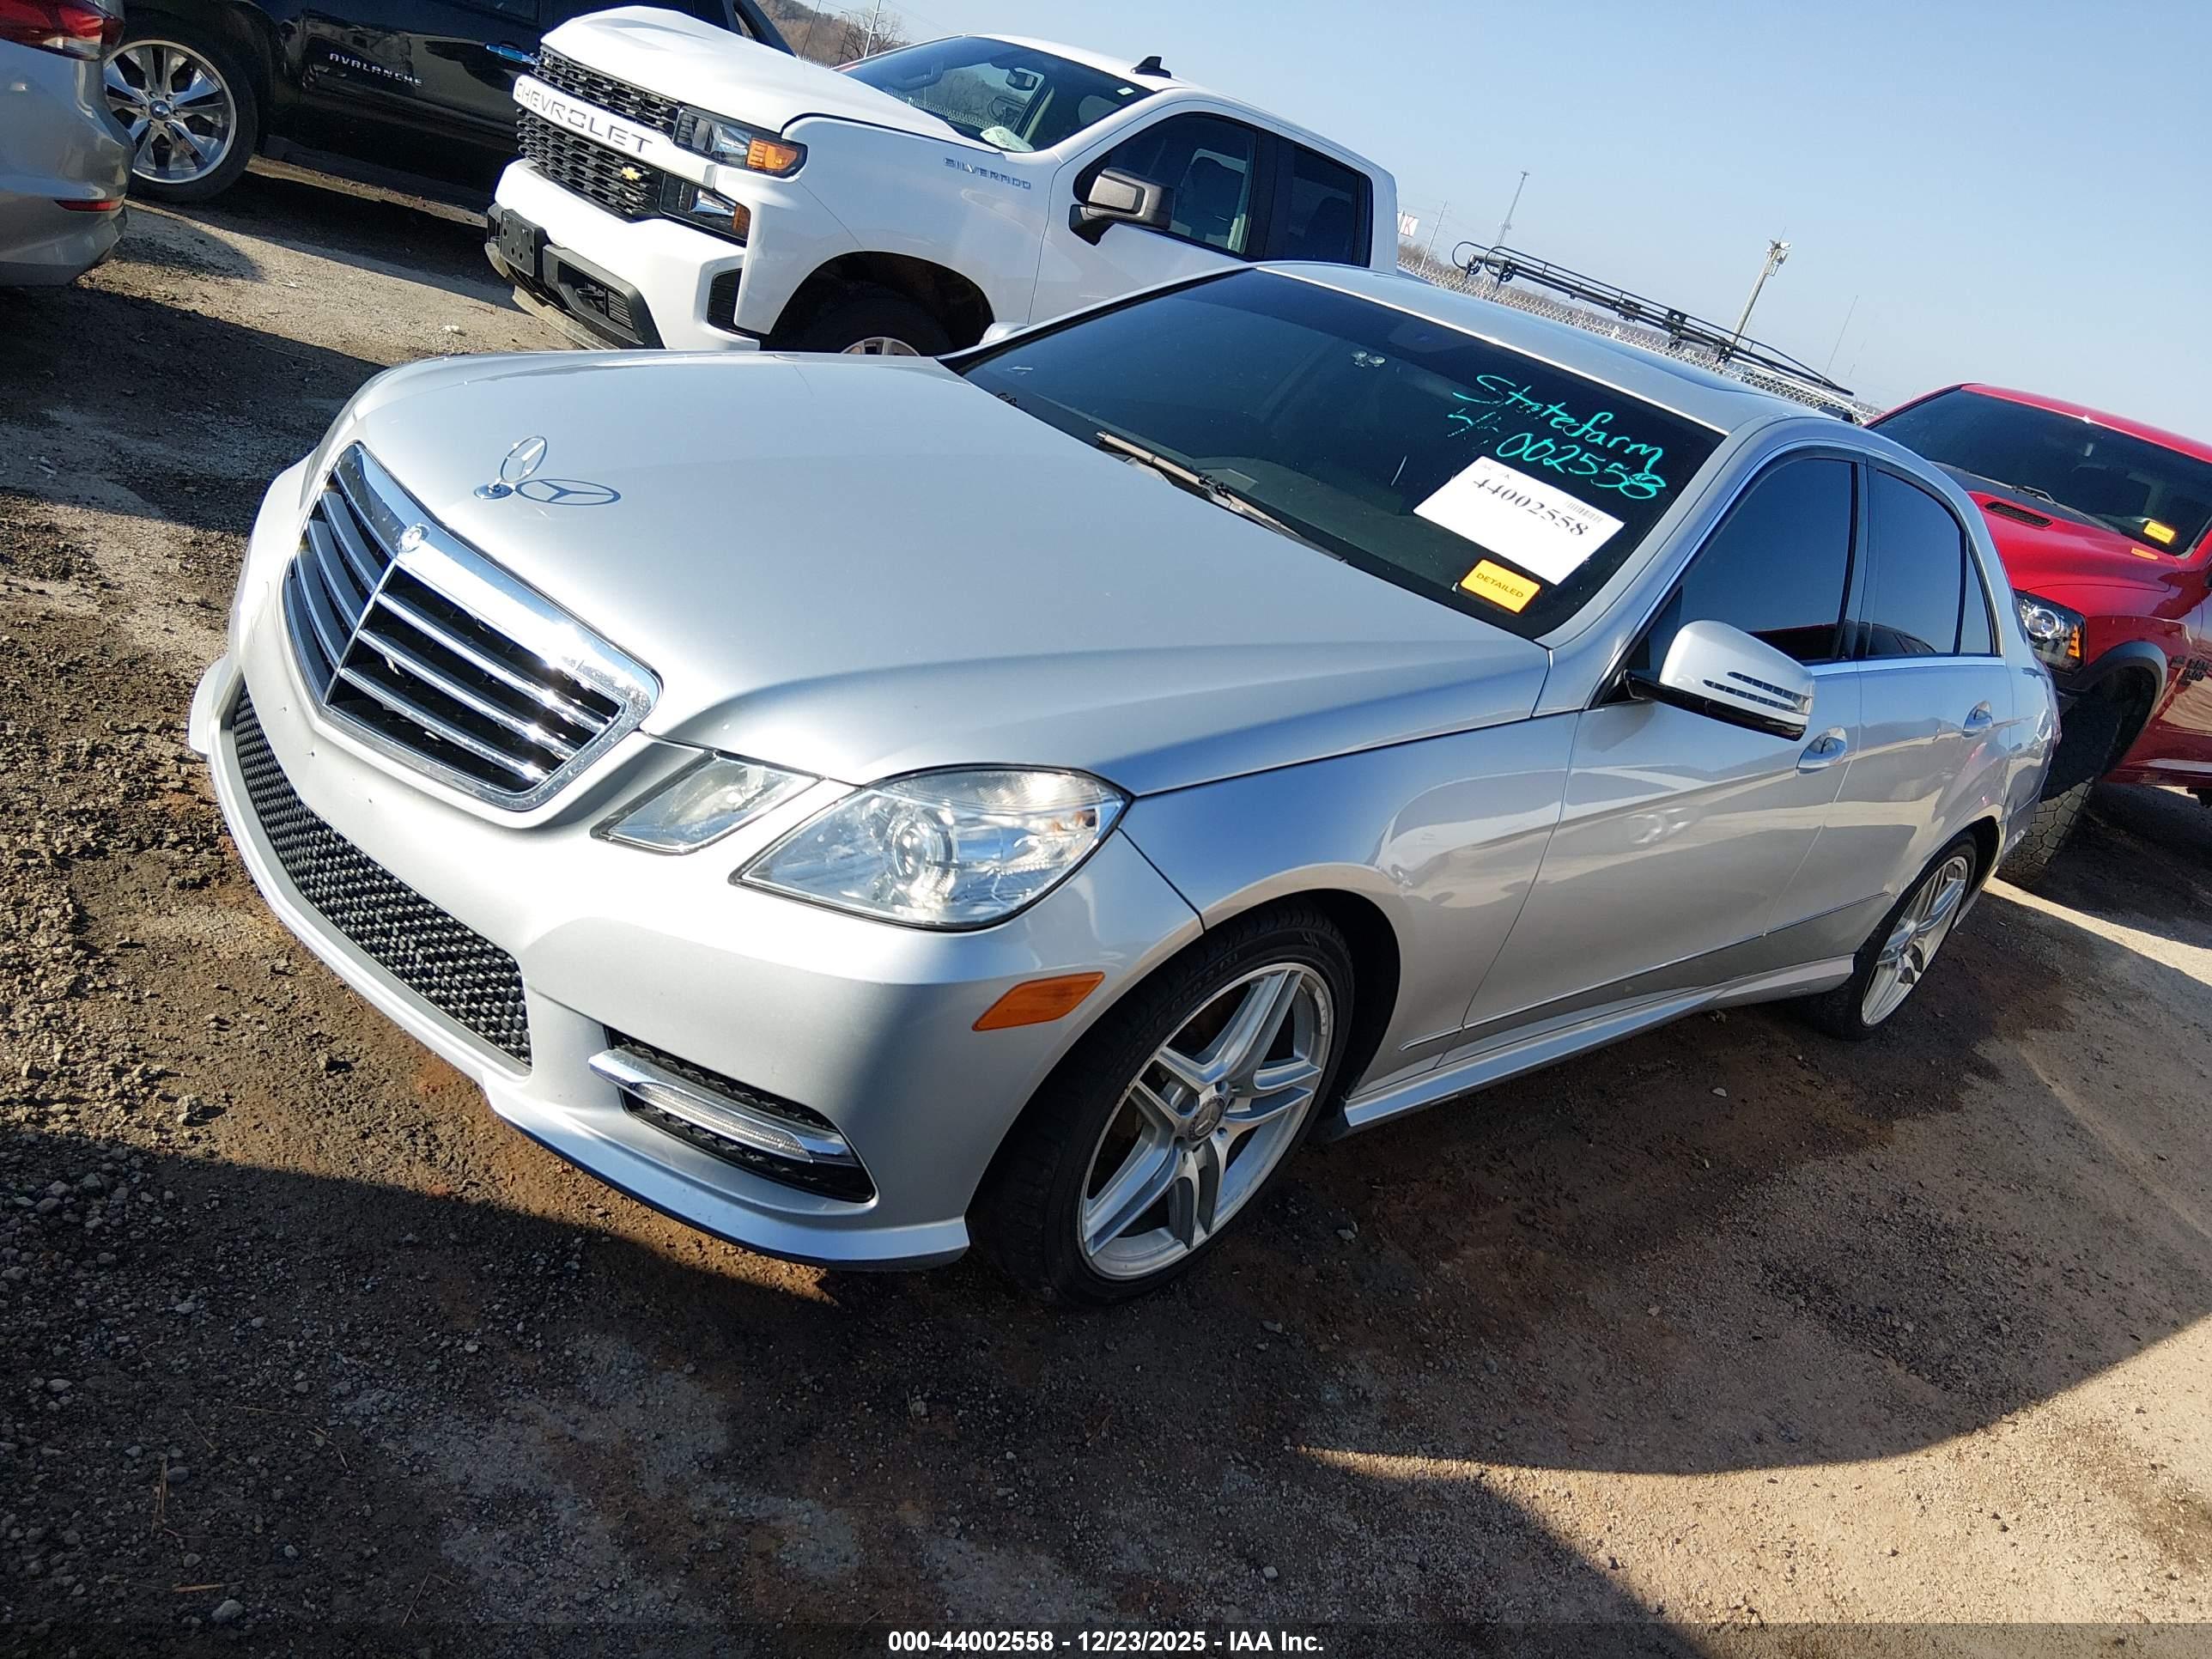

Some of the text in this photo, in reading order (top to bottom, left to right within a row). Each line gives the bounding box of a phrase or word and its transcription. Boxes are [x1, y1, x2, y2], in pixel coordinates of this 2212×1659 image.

[329, 52, 422, 88] AVALANCHE
[515, 82, 653, 154] CHEVROLET
[944, 157, 1031, 190] SILVERADO
[1473, 478, 1589, 536] 44002558
[1476, 572, 1524, 599] DETAILED
